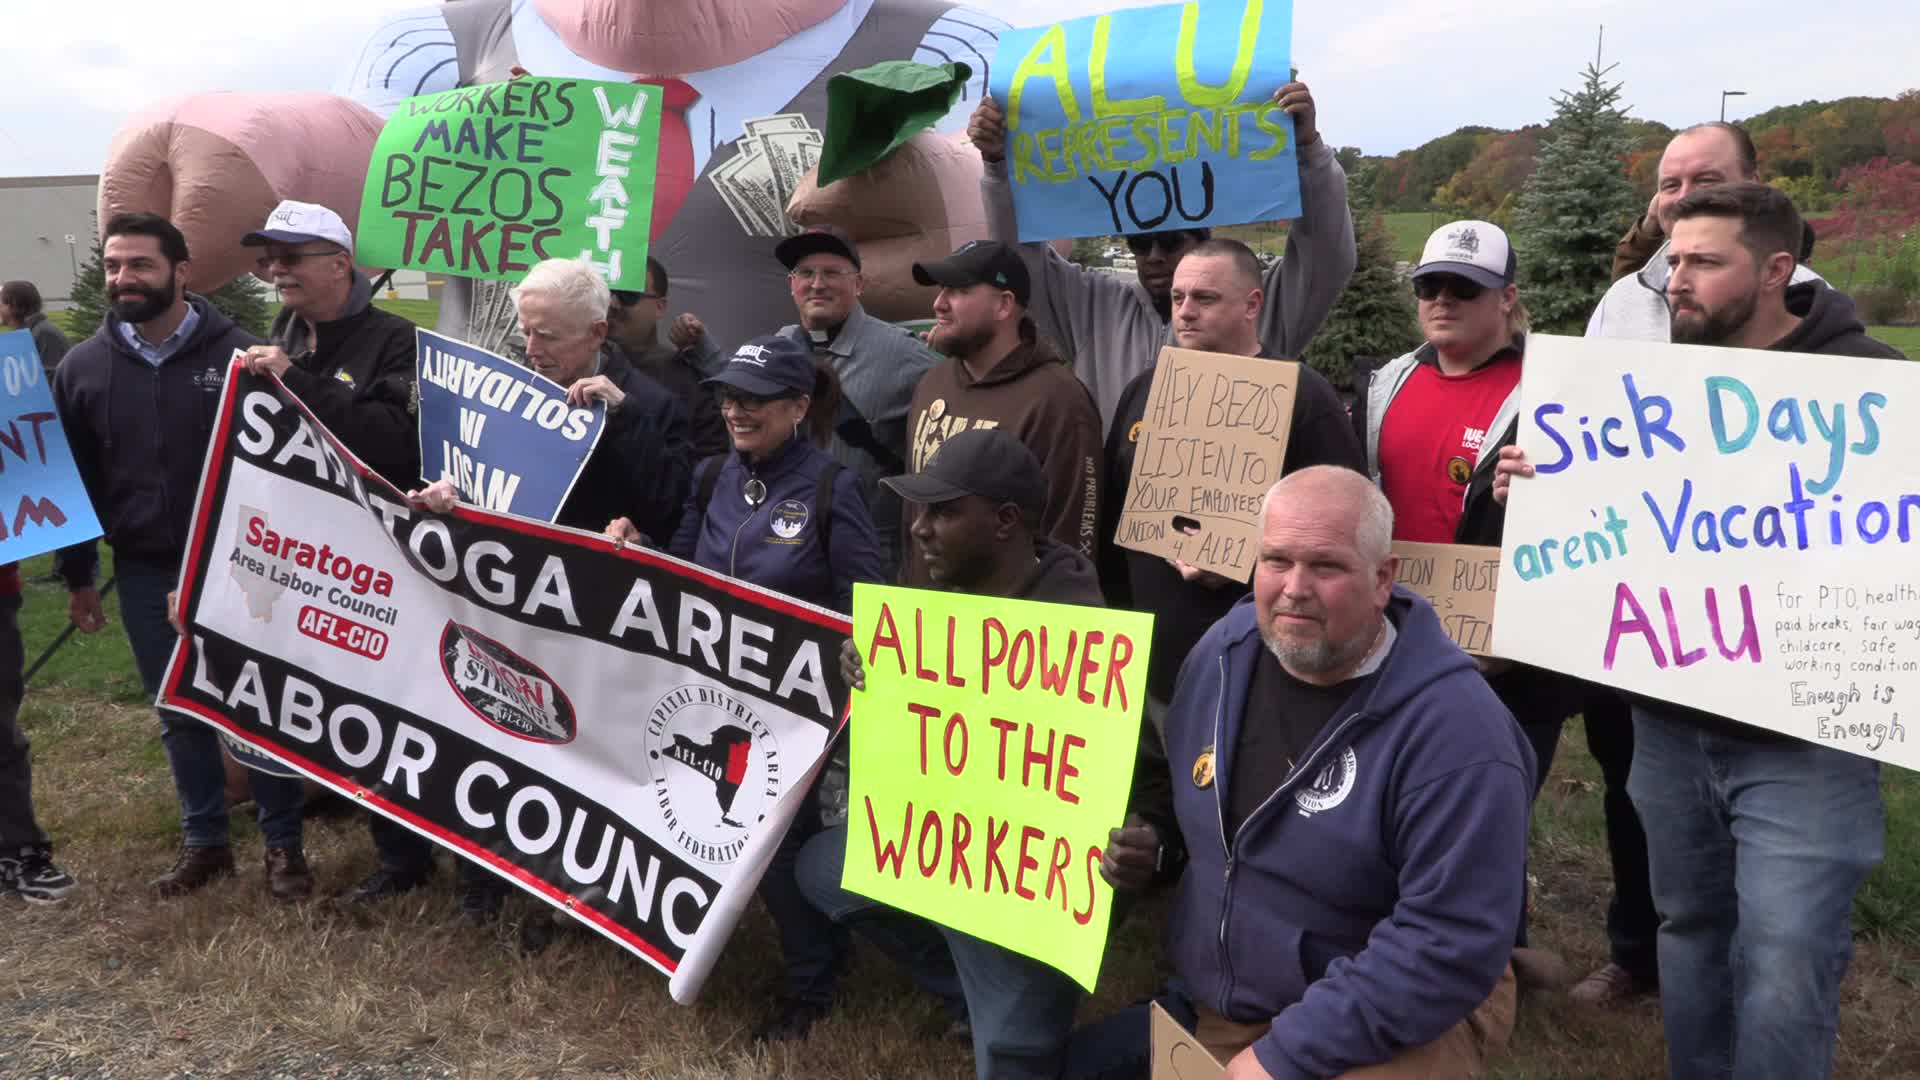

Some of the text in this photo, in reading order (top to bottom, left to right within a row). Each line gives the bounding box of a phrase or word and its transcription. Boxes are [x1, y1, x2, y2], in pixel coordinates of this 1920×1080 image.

[1007, 0, 1263, 130] ALU
[409, 80, 577, 127] WORKERS
[412, 117, 548, 163] MAKE
[1011, 99, 1289, 185] REPRESENTS
[381, 153, 572, 226] BEZOS
[1088, 161, 1214, 232] YOU
[422, 346, 594, 441] SOLIDARITY
[460, 407, 487, 449] IN
[1152, 353, 1203, 430] HEY
[1138, 432, 1267, 485] LISTEN TO
[1533, 373, 1888, 496] Sick Days
[1129, 477, 1265, 516] YOUR EMPLOYEES
[246, 516, 393, 597] Saratoga
[1119, 514, 1248, 569] UNION 4 ALB1
[230, 548, 399, 627] Area Labor Council
[1776, 581, 1804, 609] for
[1866, 583, 1920, 606] health
[300, 609, 386, 657] AFL-CIO
[609, 577, 834, 719] AREA
[869, 602, 1134, 713] ALL POWER
[1603, 582, 1763, 671] ALU
[1775, 616, 1802, 639] paid
[1808, 612, 1852, 633] breaks,
[1863, 616, 1889, 632] fair
[1779, 638, 1846, 656] childcare,
[1784, 657, 1842, 680] working
[1790, 681, 1896, 717] Enough is
[192, 633, 437, 801] LABOR
[648, 688, 779, 798] CAPITAL DISTRICT AREA
[908, 702, 1087, 805] TO THE
[1817, 712, 1906, 752] Enough
[673, 745, 723, 781] AFL-CIO
[655, 778, 750, 863] LABOR FEDERATIO
[864, 795, 1103, 925] WORKERS
